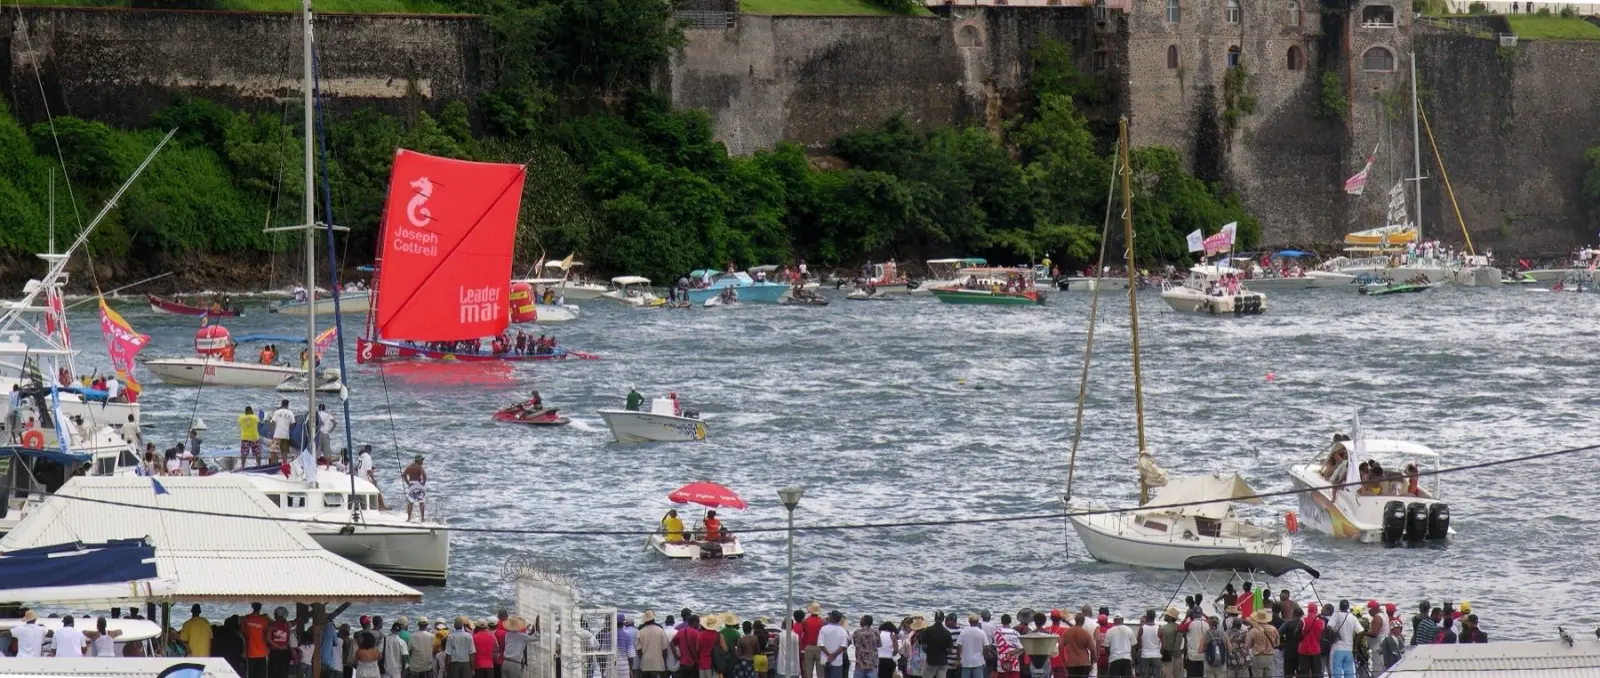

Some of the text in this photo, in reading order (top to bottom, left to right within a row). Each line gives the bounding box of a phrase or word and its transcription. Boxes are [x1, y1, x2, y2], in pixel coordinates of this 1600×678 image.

[394, 225, 438, 244] Joseph
[393, 238, 438, 257] Cottrell
[459, 285, 501, 303] Leader
[460, 302, 501, 324] mat
